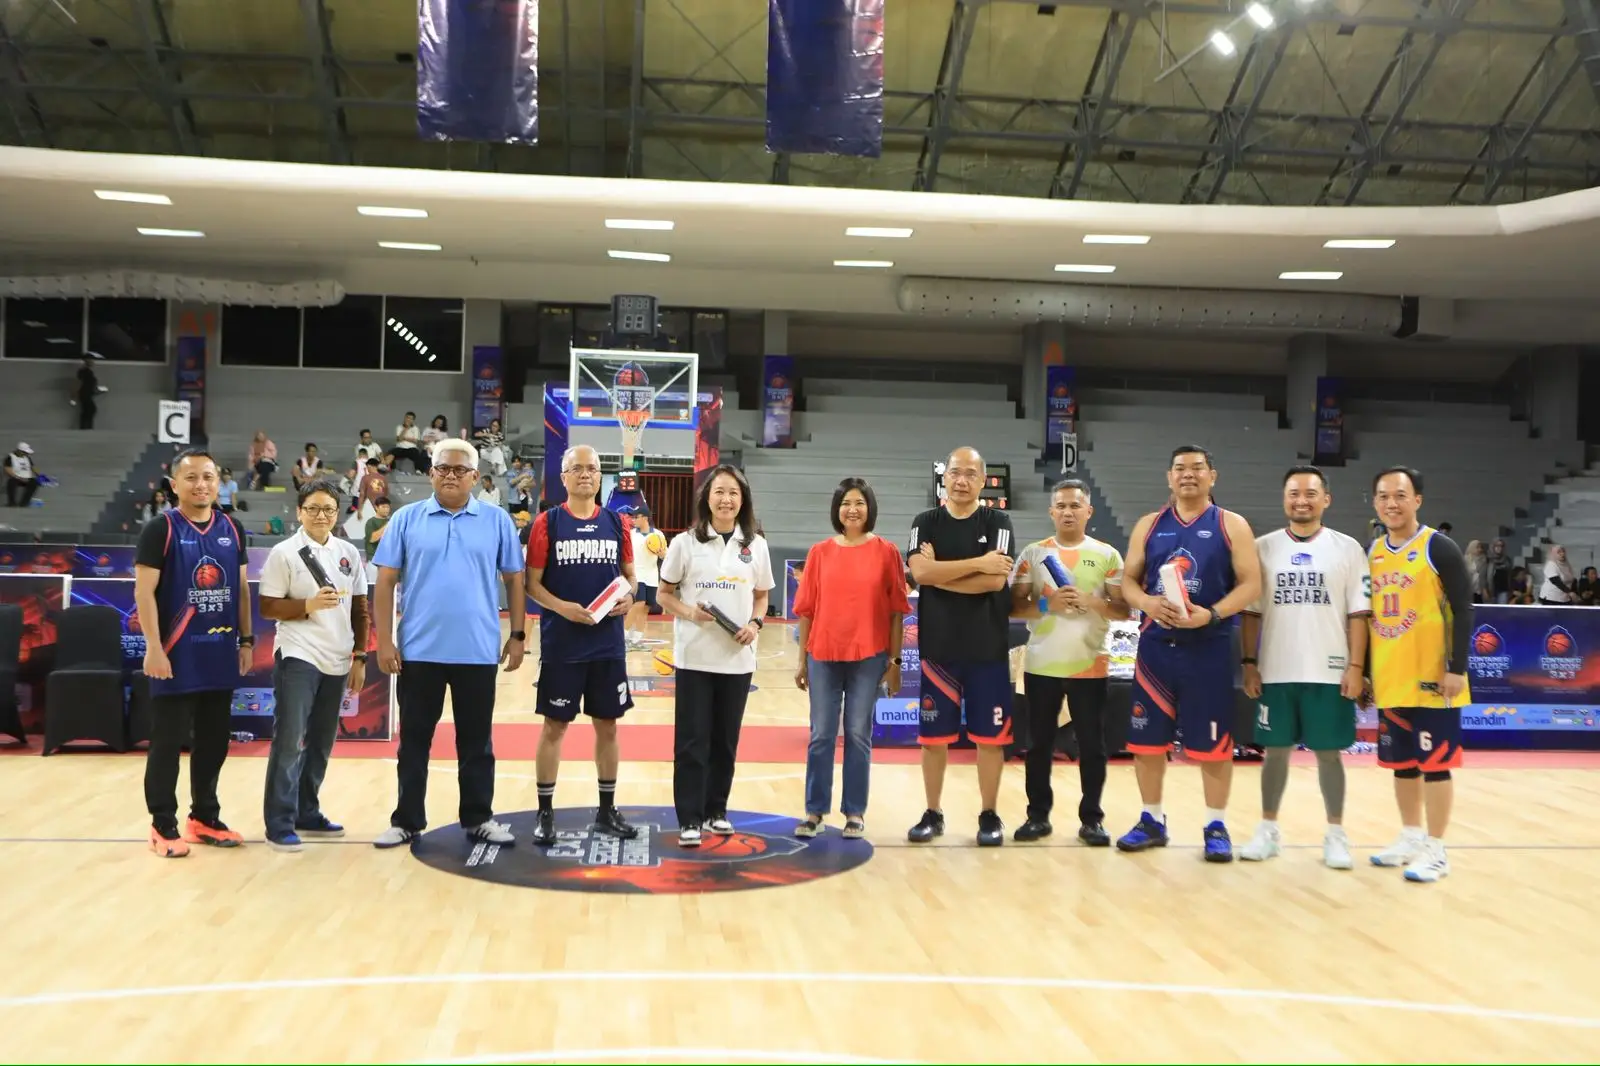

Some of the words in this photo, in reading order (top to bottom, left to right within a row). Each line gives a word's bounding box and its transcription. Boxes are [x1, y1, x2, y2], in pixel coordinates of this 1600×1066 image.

[165, 413, 184, 438] C
[1065, 444, 1076, 468] D
[556, 540, 617, 560] CORPORATE
[1083, 559, 1095, 567] YTS
[1276, 572, 1326, 587] GRAHA
[188, 589, 230, 597] CONTAINER
[1274, 589, 1331, 605] SEGARA
[1382, 593, 1399, 617] 11
[617, 682, 627, 706] 2
[993, 706, 1003, 726] 2
[1462, 713, 1506, 726] mandiri
[1210, 720, 1218, 741] 1
[1419, 731, 1433, 752] 6
